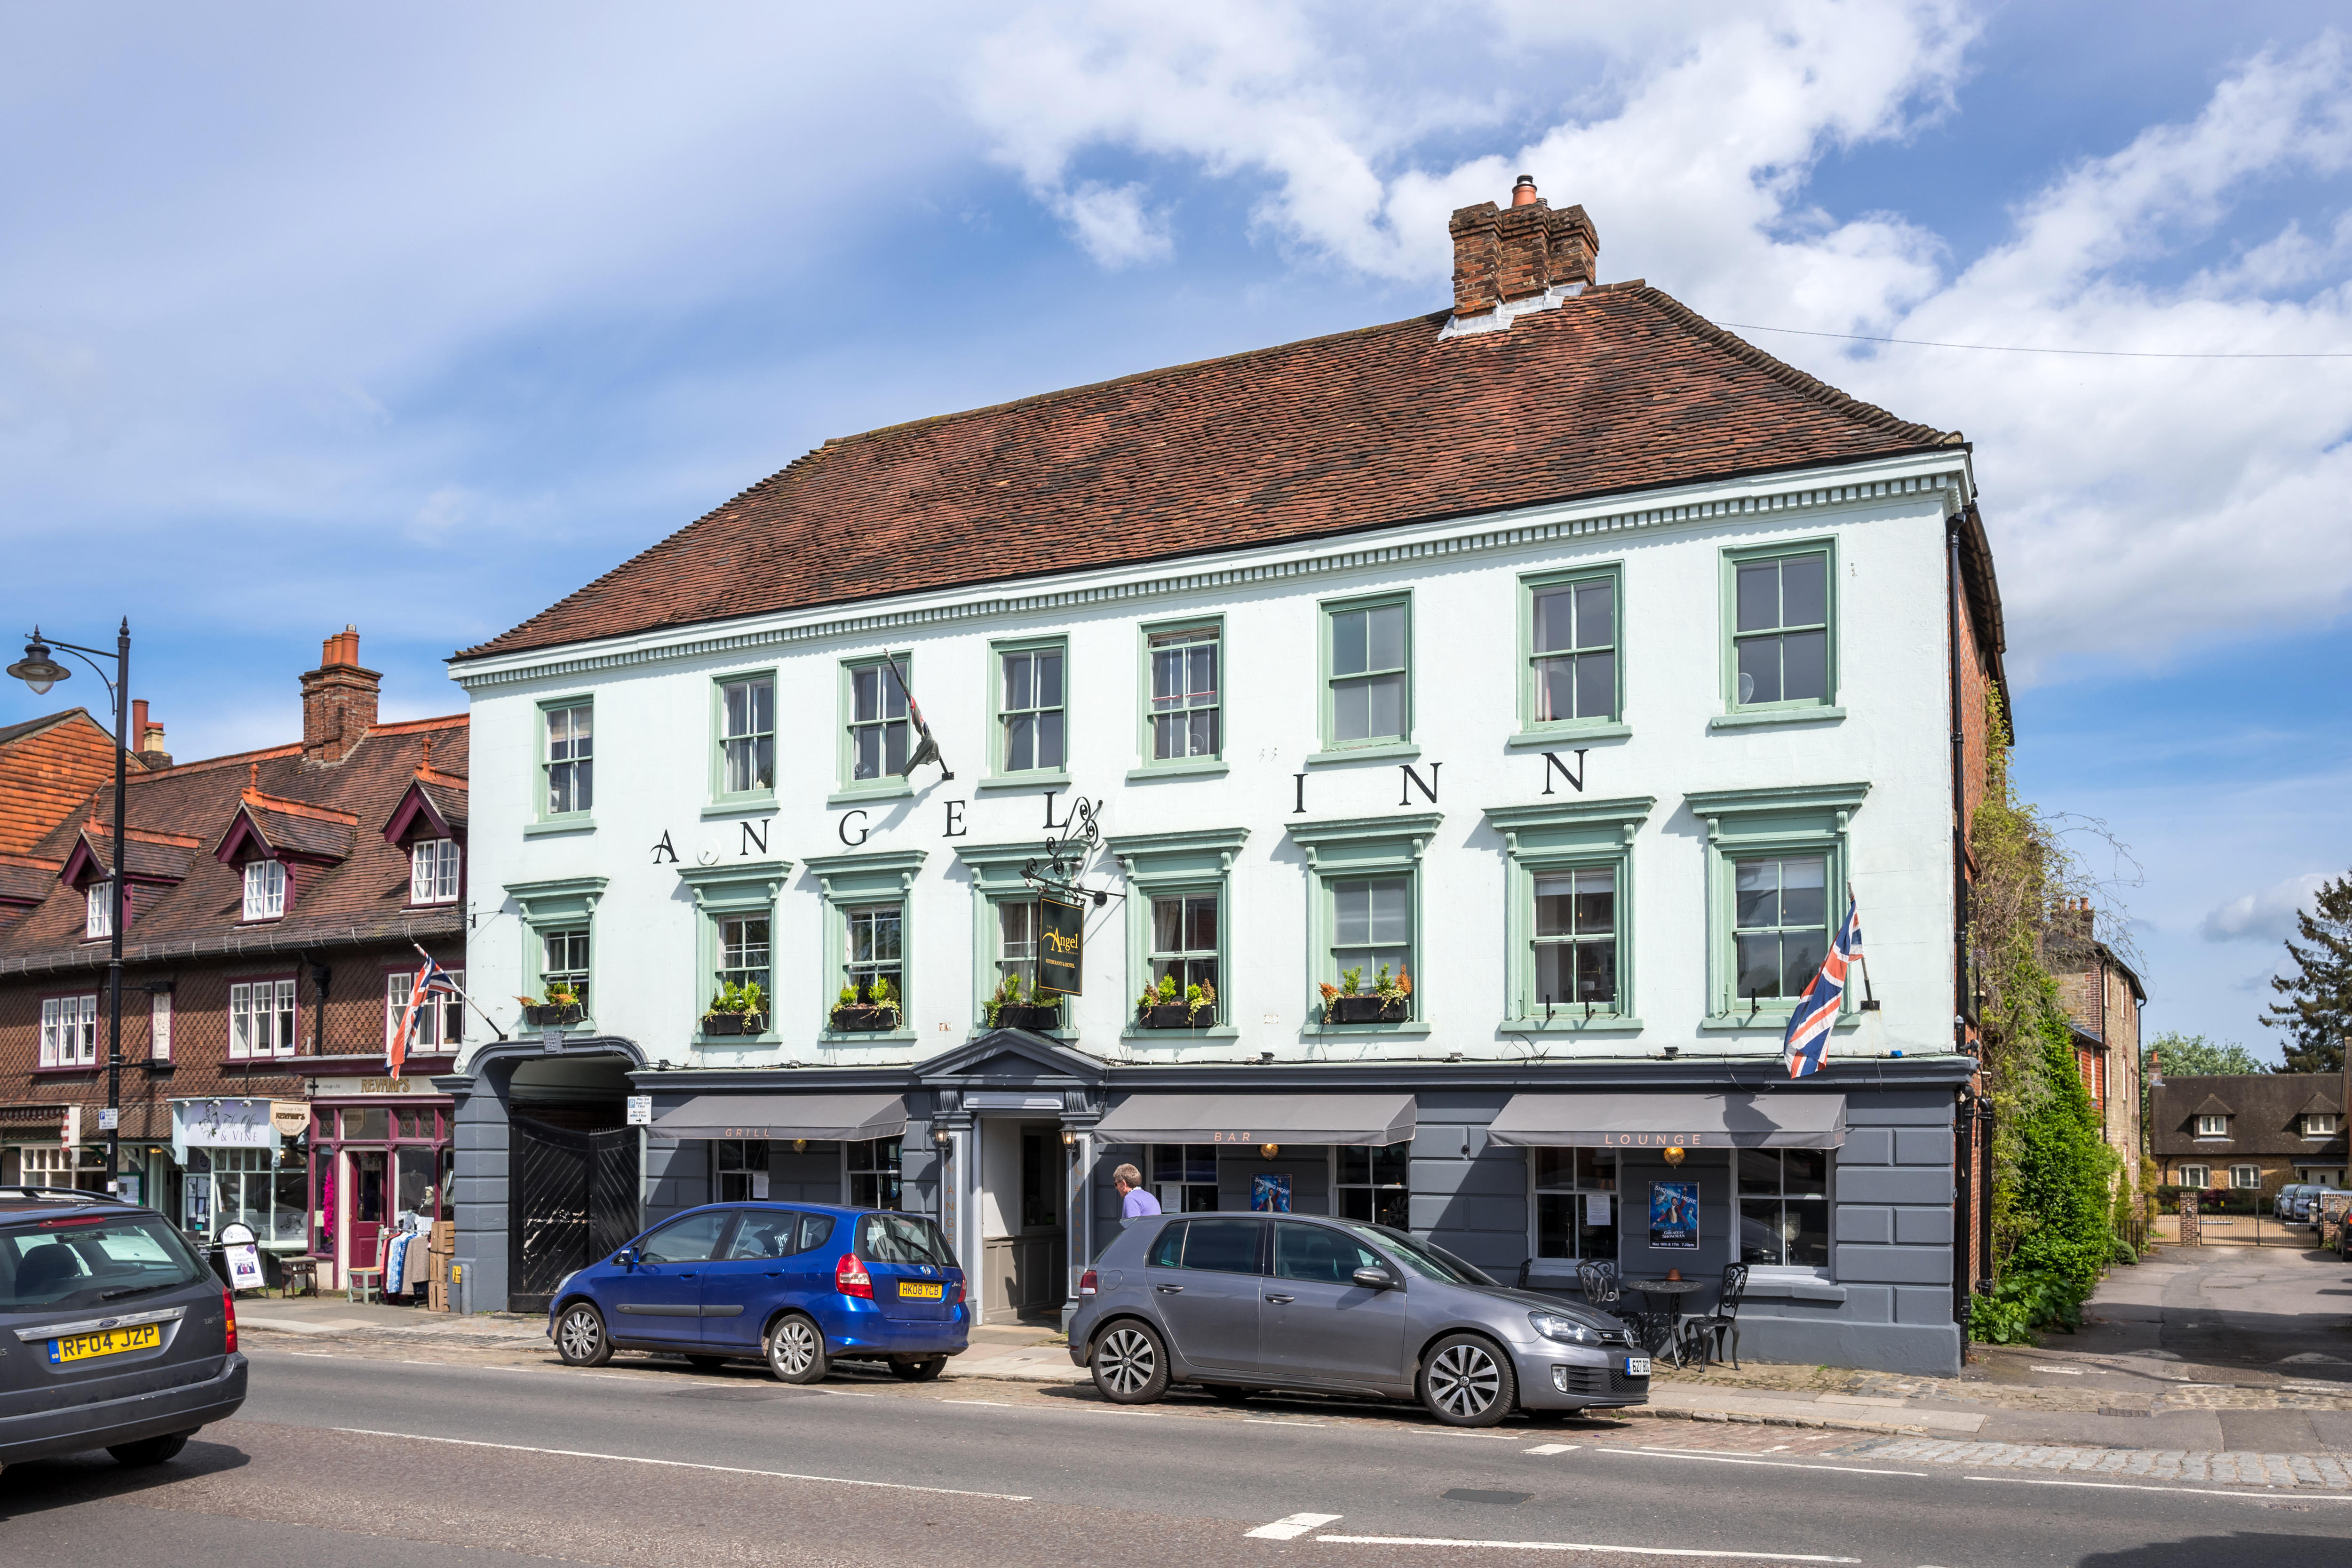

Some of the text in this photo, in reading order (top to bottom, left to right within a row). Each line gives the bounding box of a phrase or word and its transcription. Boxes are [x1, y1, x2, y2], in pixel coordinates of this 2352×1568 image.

[650, 749, 1589, 864] ANGEL INN
[1042, 927, 1078, 953] Angel
[361, 1078, 410, 1093] REVAMPS
[222, 1113, 238, 1130] The
[241, 1113, 261, 1130] Olive
[221, 1130, 257, 1142] & VINE
[725, 1129, 770, 1137] GRILL
[1215, 1132, 1250, 1141] BAR
[1605, 1134, 1701, 1145] LOUNGE
[1255, 1178, 1289, 1195] SHOWING HERE
[1654, 1186, 1697, 1204] SHOWING HERE
[946, 1186, 954, 1244] ANGE
[903, 1284, 938, 1296] HK08 YCB
[62, 1327, 154, 1357] RF04 JZP
